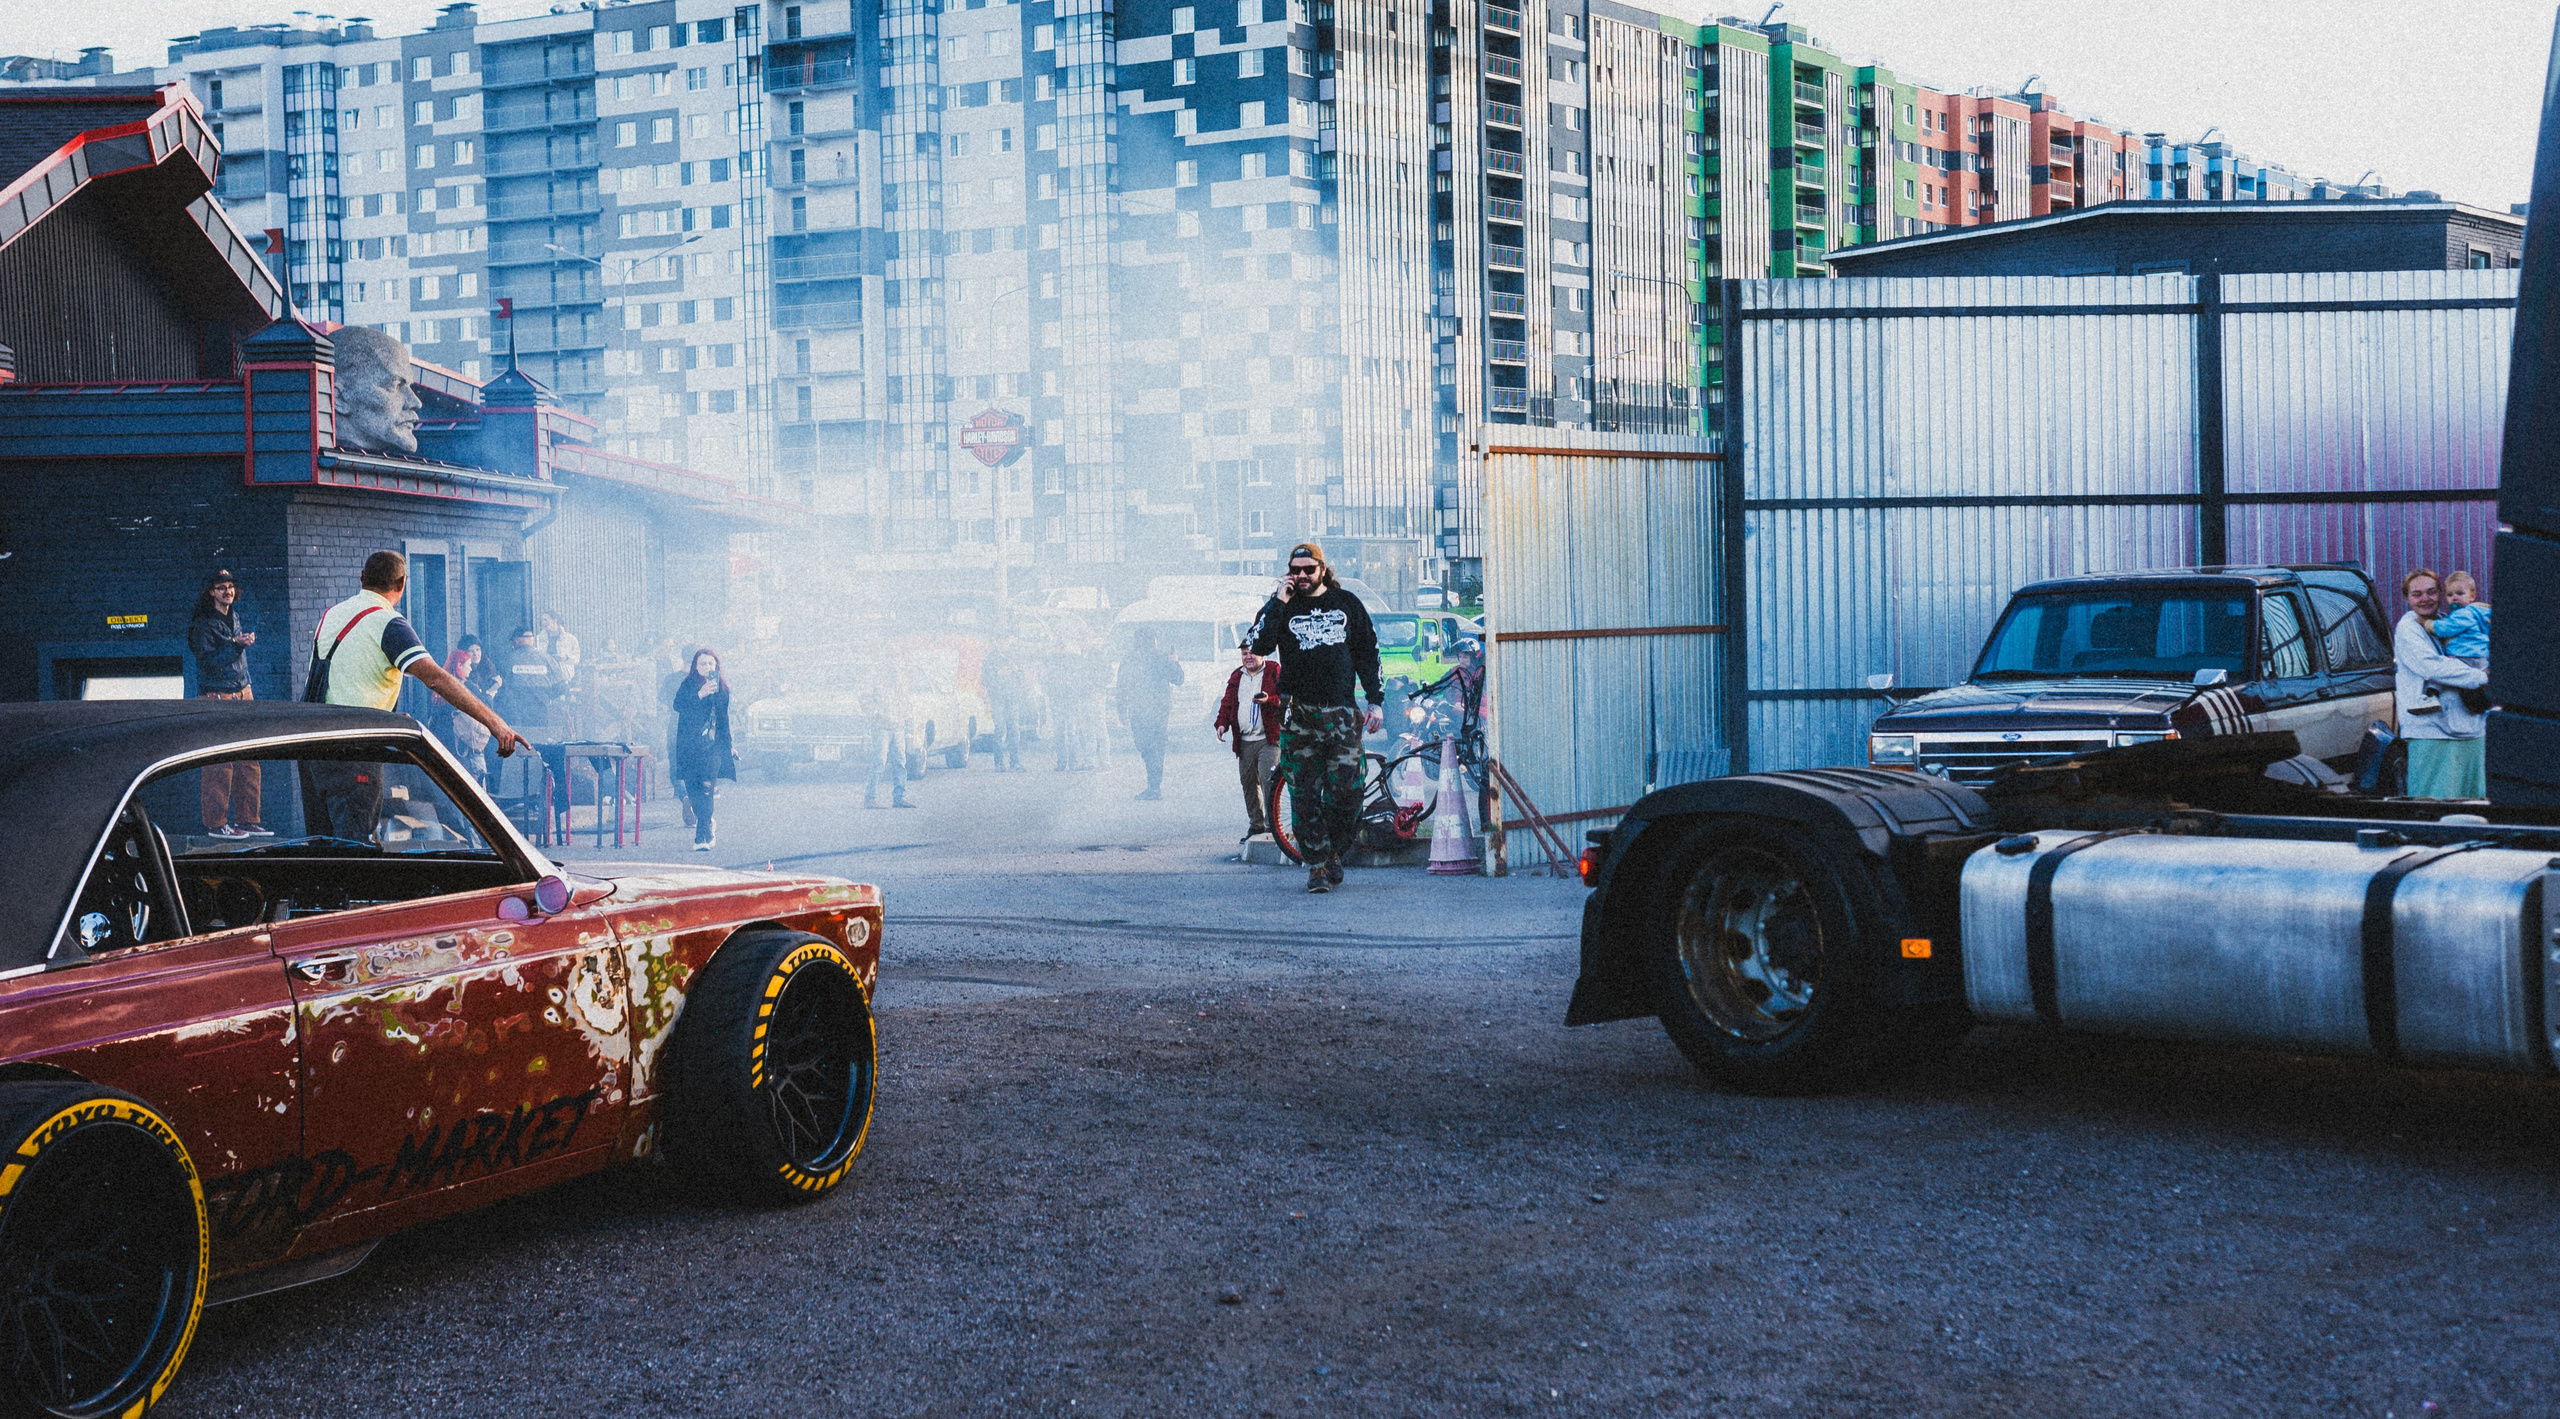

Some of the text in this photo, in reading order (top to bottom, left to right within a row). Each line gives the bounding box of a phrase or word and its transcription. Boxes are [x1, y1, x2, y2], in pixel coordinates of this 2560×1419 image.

[975, 414, 1004, 427] MOTOR
[963, 430, 1016, 444] HARLEY-DAVIDSON
[975, 447, 1004, 461] CYCLES
[788, 948, 832, 968] TOYO
[32, 1104, 197, 1180] TOYO TIRES
